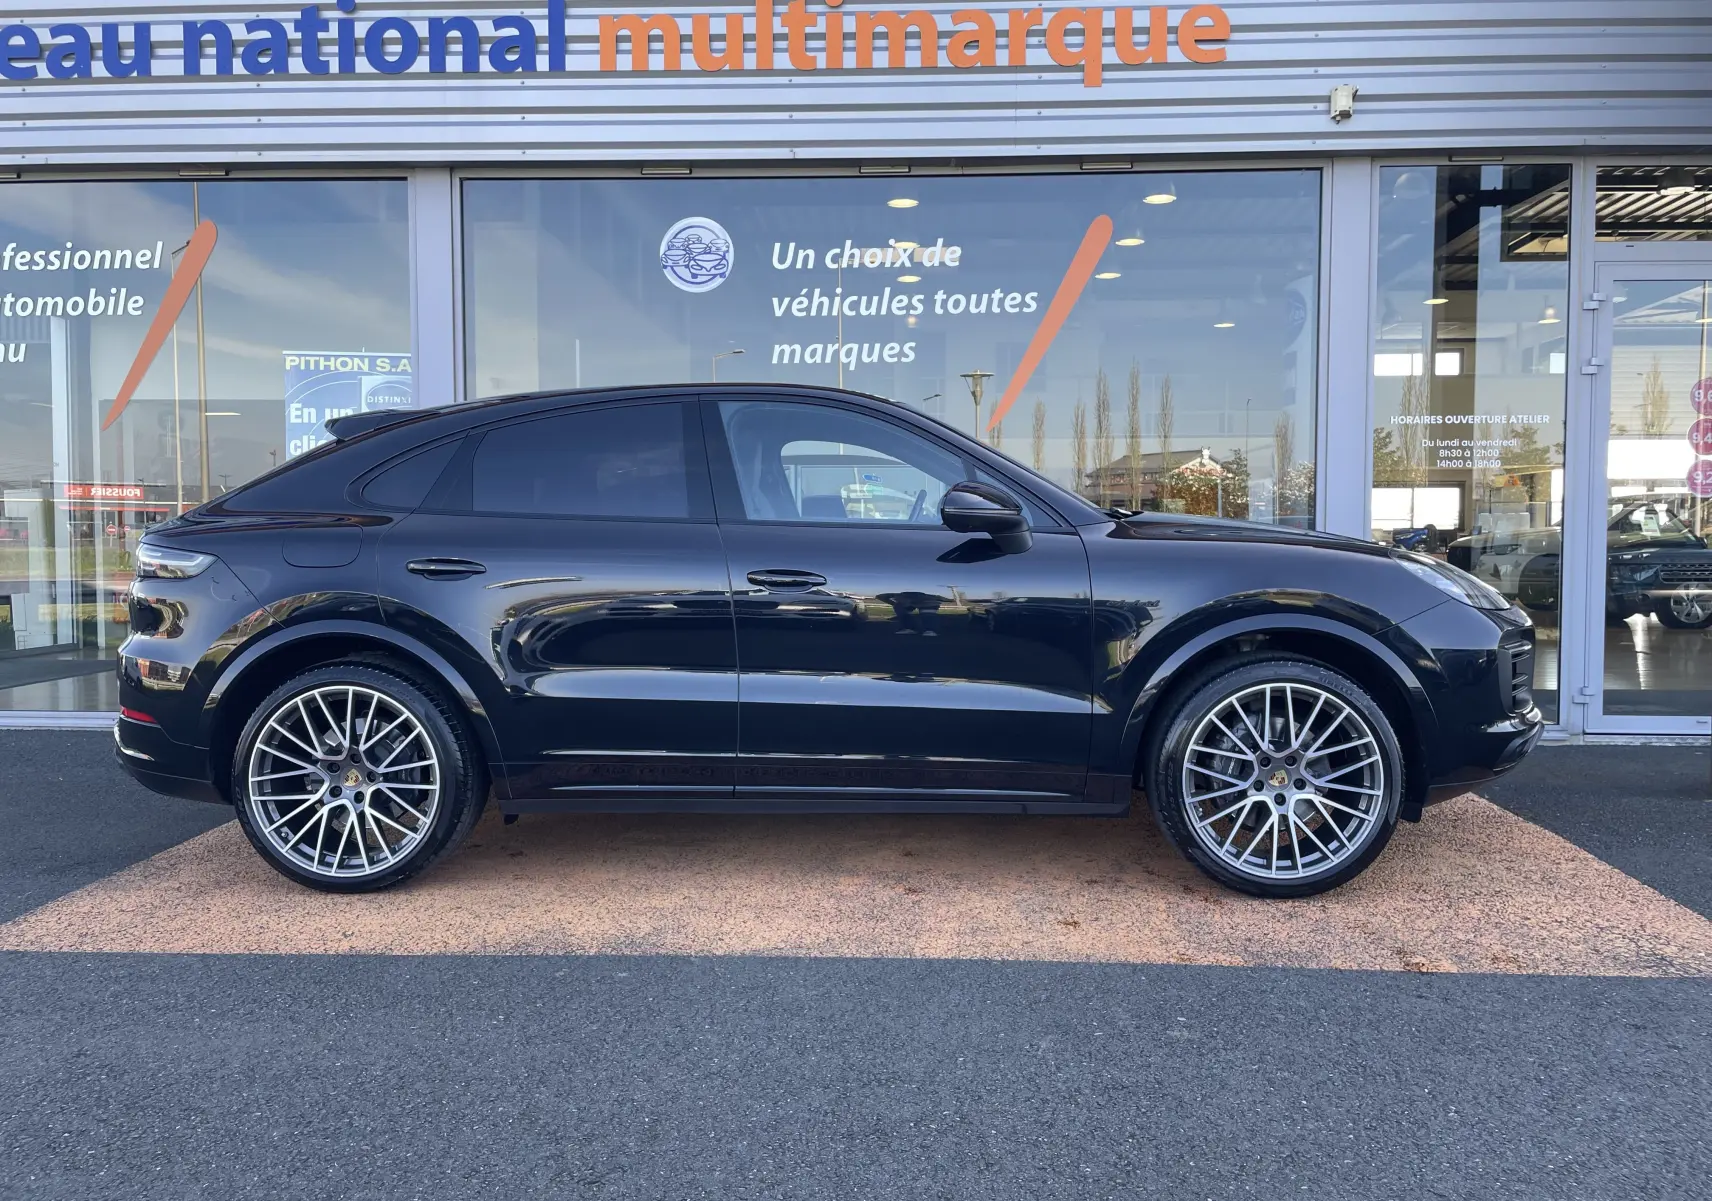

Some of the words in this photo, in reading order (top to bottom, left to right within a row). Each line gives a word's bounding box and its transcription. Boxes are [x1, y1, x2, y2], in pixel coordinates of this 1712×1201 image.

[0, 22, 151, 79] eau
[183, 0, 566, 76] national
[599, 0, 1232, 88] multimarque
[2, 241, 164, 271] fessionnel
[771, 241, 815, 270] Un
[824, 238, 914, 269] choix
[922, 237, 963, 268] de
[771, 286, 925, 317] véhicules
[933, 287, 1039, 315] toutes
[285, 356, 370, 372] PITHON
[771, 339, 917, 371] marques
[289, 402, 317, 424] En
[1390, 415, 1443, 425] HORAIRES
[1444, 415, 1507, 424] OUVERTURE
[1509, 414, 1550, 424] ATELIER
[1421, 439, 1435, 447] Du
[1436, 438, 1460, 447] lundi
[1476, 438, 1517, 447] vendredi
[1439, 449, 1463, 457] 8h30
[1464, 448, 1471, 457] à
[1473, 449, 1500, 457] 12h00
[1437, 459, 1464, 468] 14h00
[1465, 459, 1473, 468] à
[1474, 459, 1502, 468] 18h00
